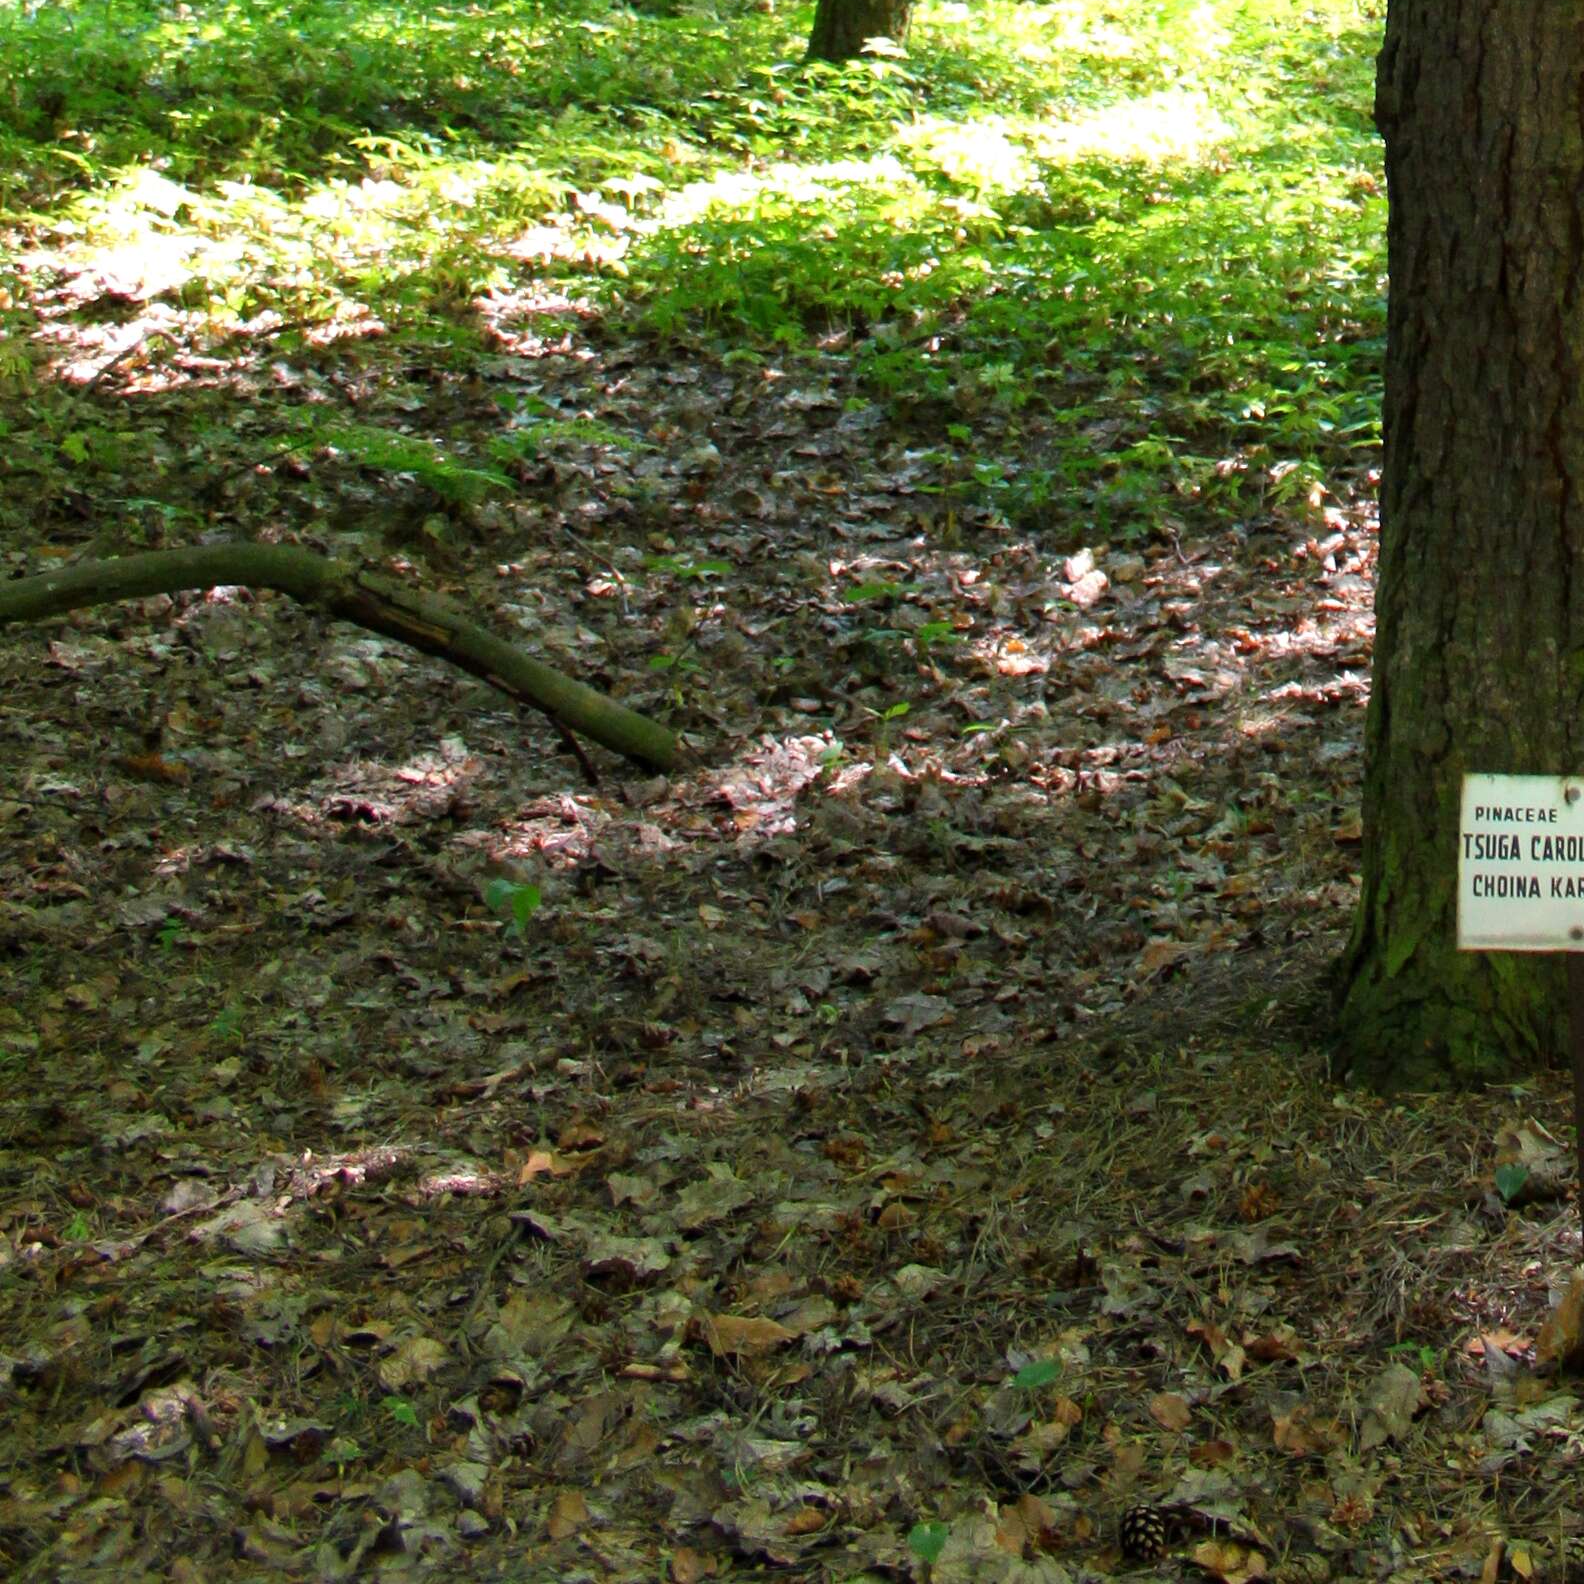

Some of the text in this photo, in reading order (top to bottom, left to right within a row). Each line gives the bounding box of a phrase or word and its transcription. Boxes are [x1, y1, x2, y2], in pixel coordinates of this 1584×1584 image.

[1475, 806, 1558, 823] PINACEAE
[1463, 833, 1521, 860] TSUGA
[1472, 874, 1541, 898] CHOINA
